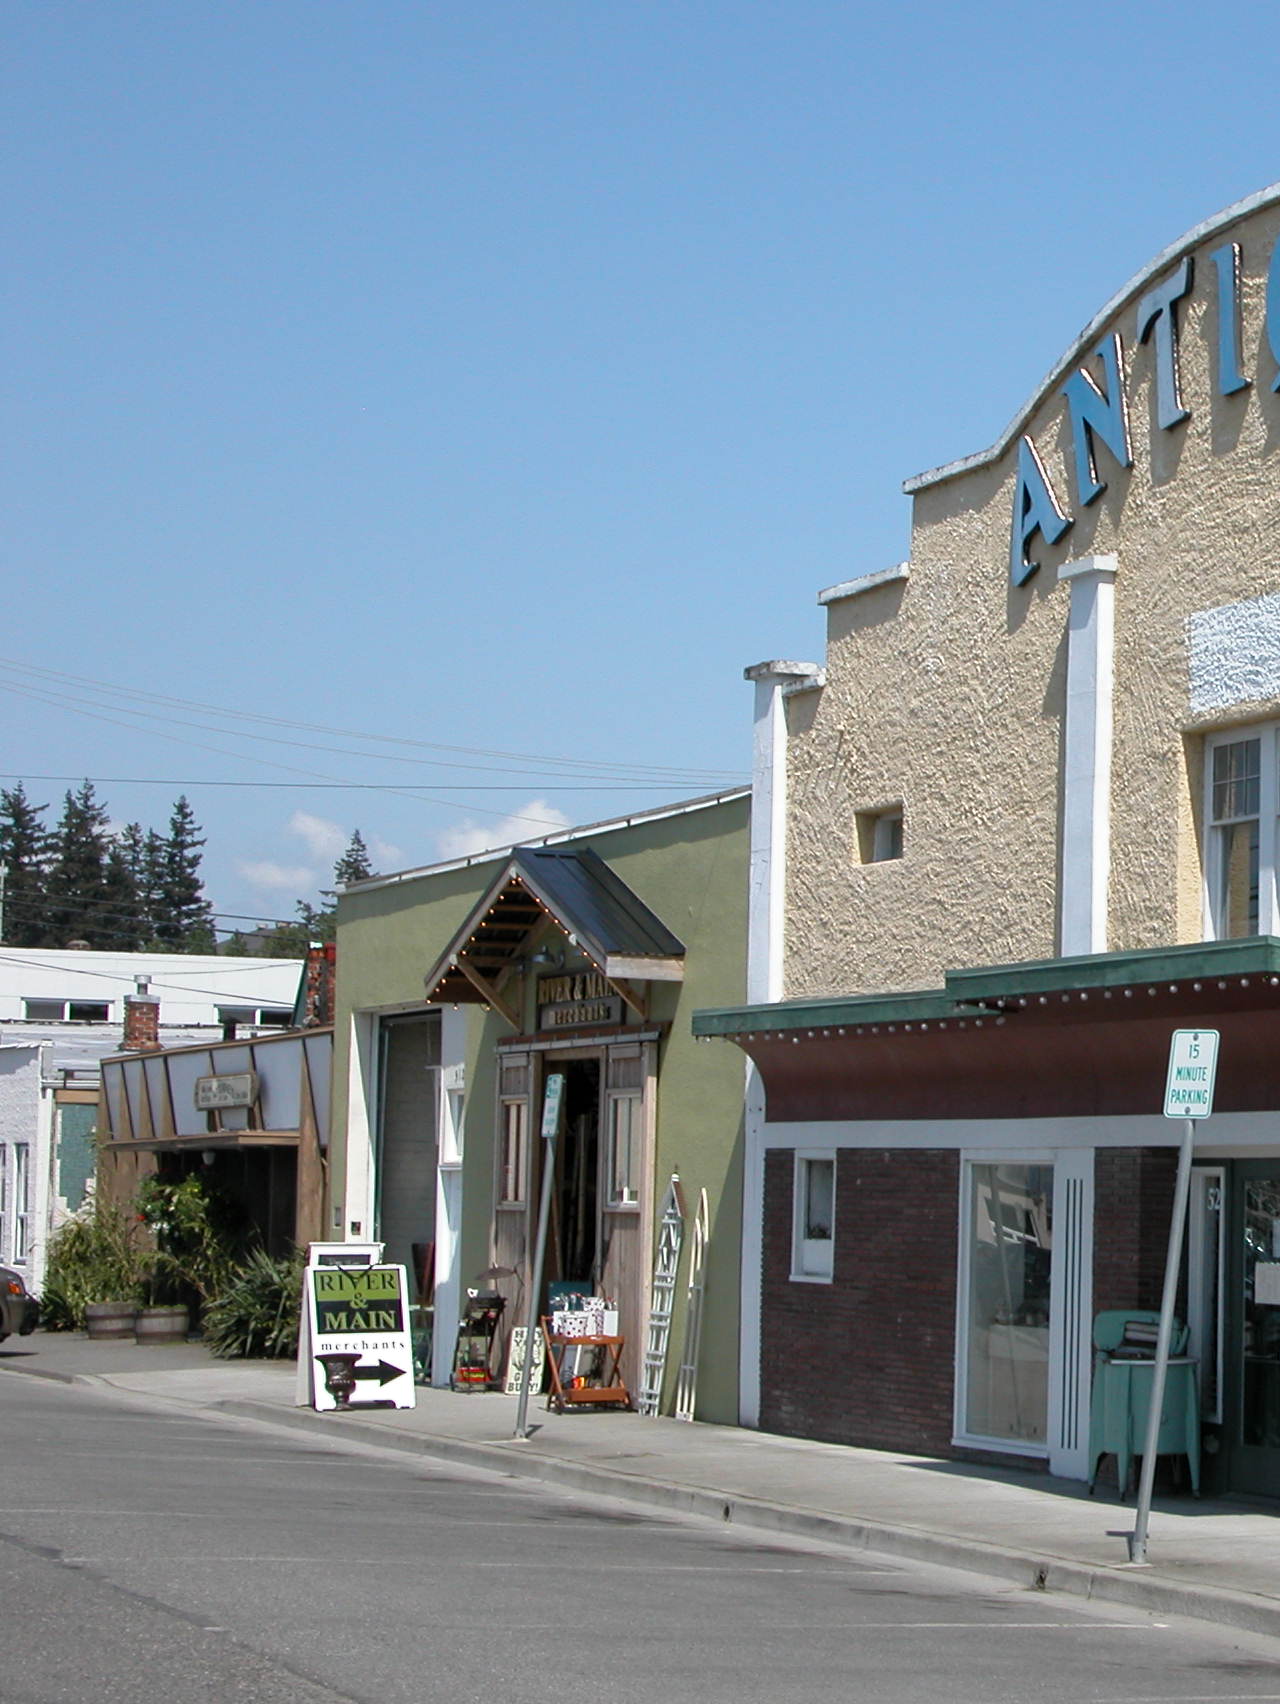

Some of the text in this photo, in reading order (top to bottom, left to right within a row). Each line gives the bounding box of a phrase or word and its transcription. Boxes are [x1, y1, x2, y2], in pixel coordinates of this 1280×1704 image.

[573, 974, 583, 1000] &
[1188, 1044, 1200, 1059] 15
[1175, 1066, 1208, 1081] MINUTE
[1170, 1088, 1208, 1105] PARKING
[319, 1272, 397, 1292] RIVER
[350, 1292, 369, 1310] &
[324, 1310, 397, 1331] MAIN
[321, 1340, 405, 1351] merchants
[507, 1382, 539, 1392] BUY!
